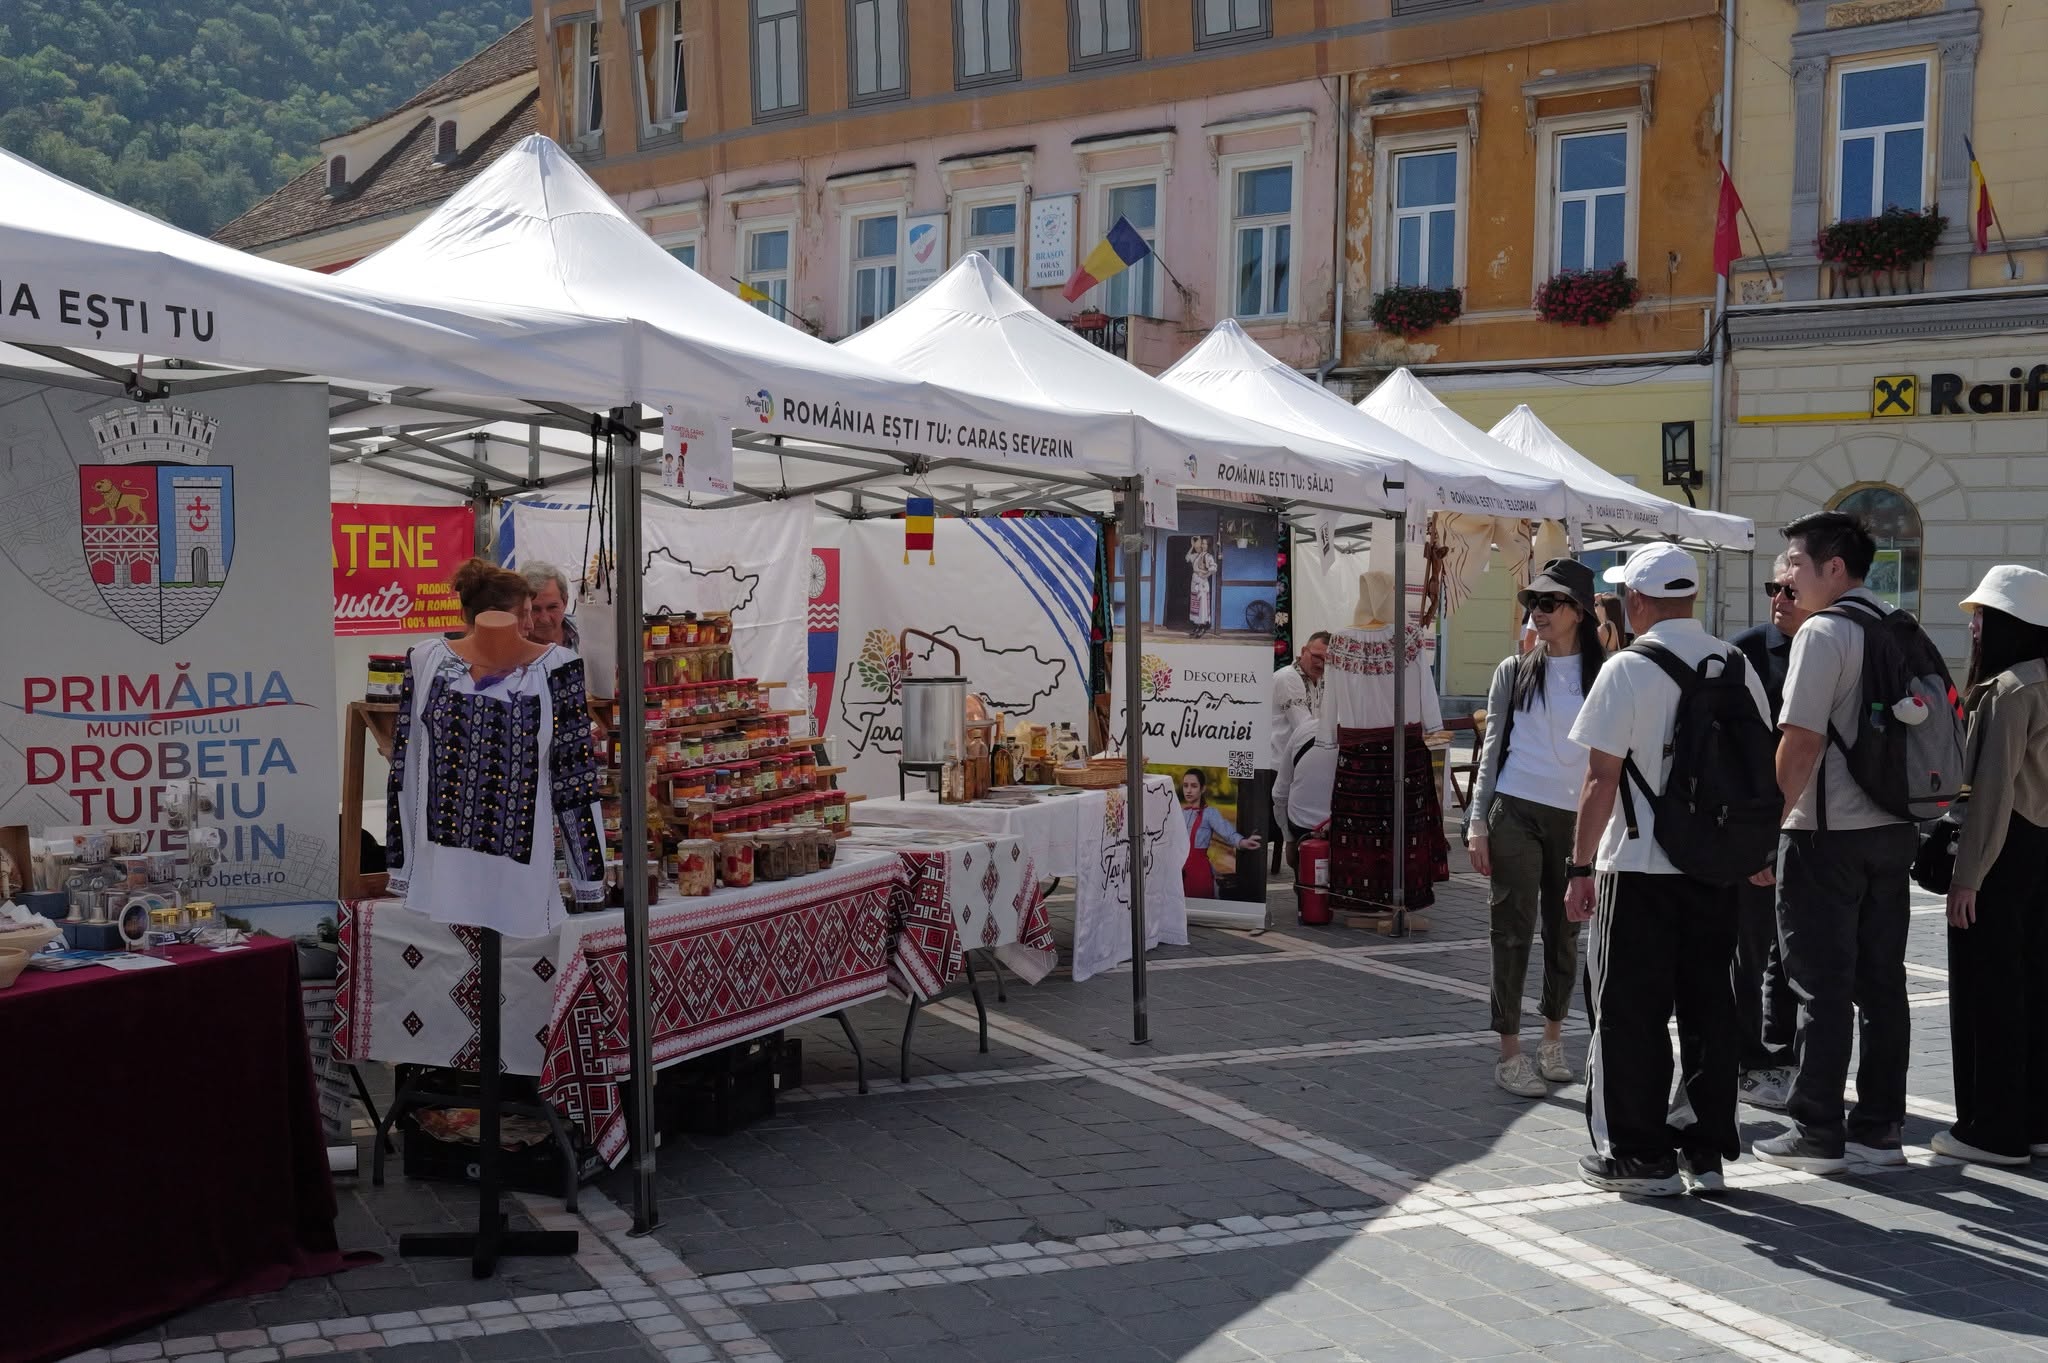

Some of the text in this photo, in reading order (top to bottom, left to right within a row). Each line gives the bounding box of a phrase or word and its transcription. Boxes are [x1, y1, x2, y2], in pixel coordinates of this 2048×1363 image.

[0, 280, 214, 342] A EȘTI TU
[783, 397, 1074, 458] ROMÂNIA EȘTI TU: CARAȘ SEVERIN
[1217, 463, 1334, 493] ROMÂNIA EȘTI TU: SĂLAJ
[333, 513, 438, 576] ȚENE
[333, 581, 414, 619] usite
[402, 617, 426, 629] 100%
[24, 662, 296, 714] PRIMĂRIA
[87, 718, 240, 738] MUNICIPIULUI
[1171, 705, 1253, 748] Silvaniei
[26, 737, 297, 785] DROBETA
